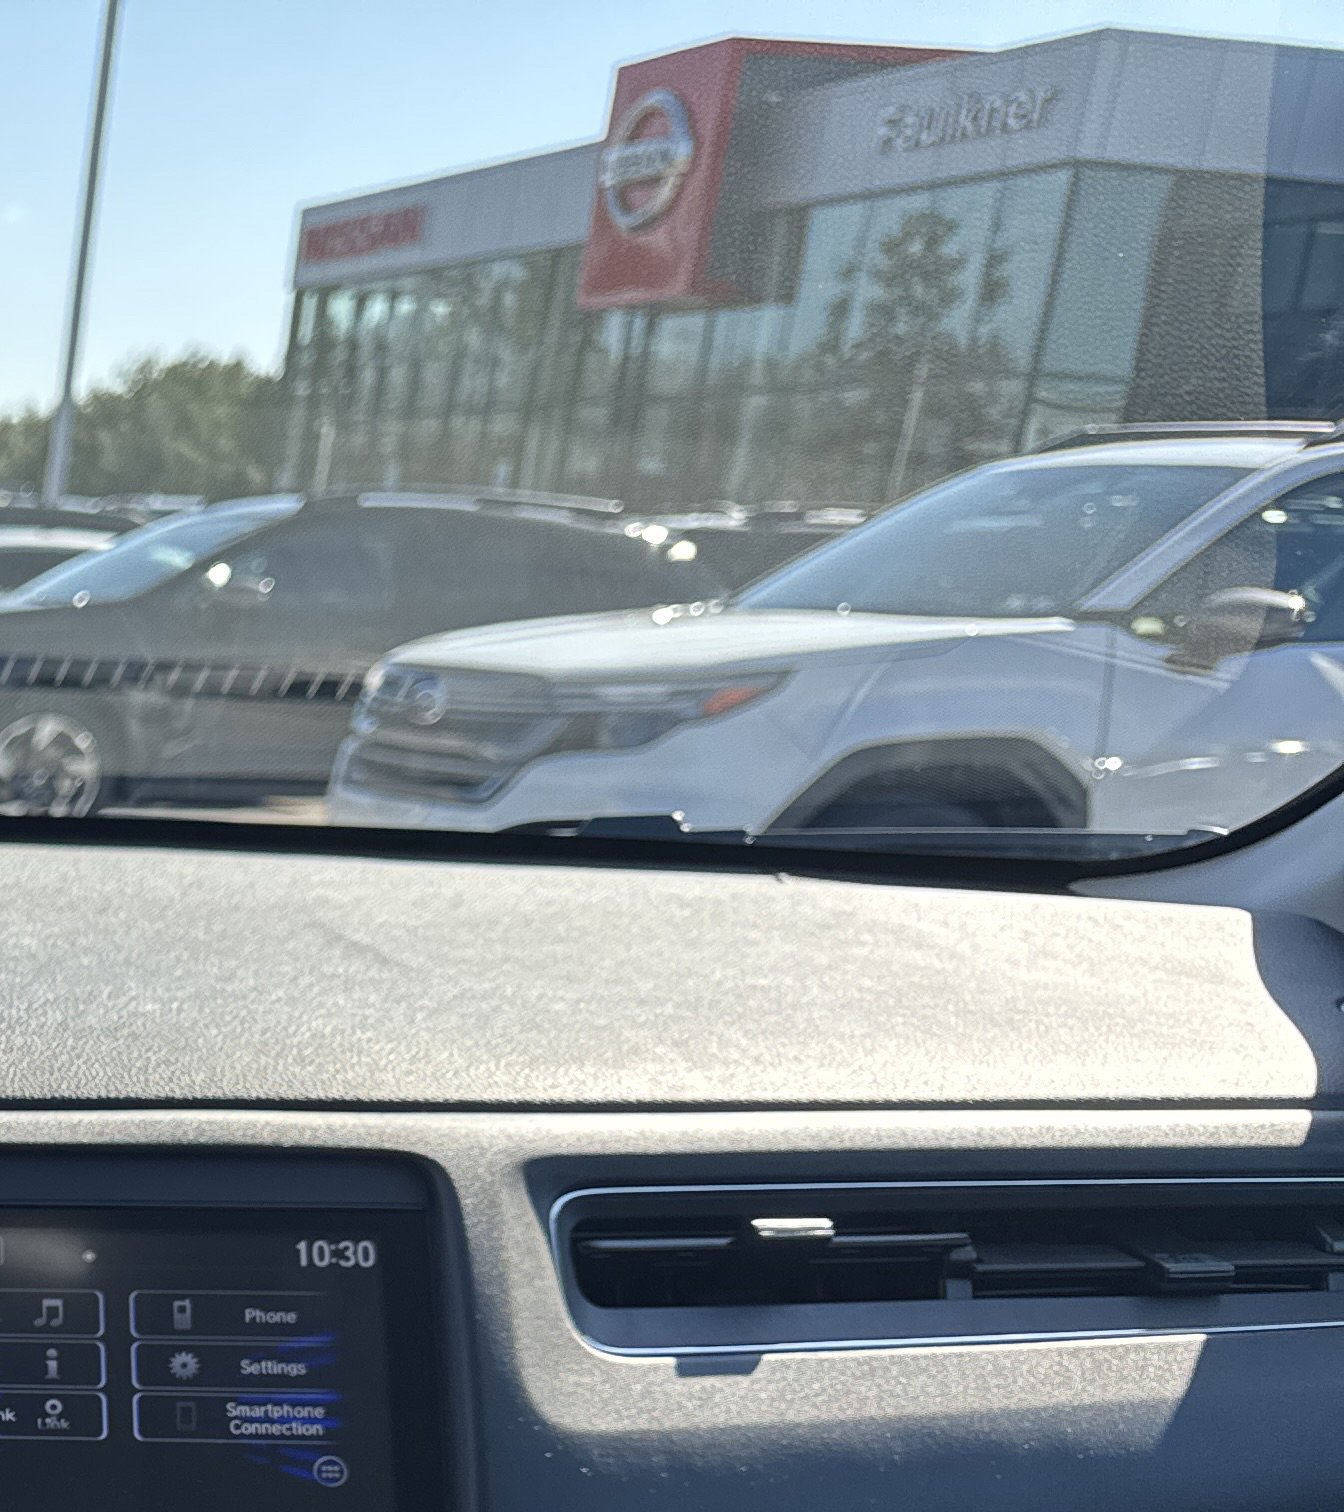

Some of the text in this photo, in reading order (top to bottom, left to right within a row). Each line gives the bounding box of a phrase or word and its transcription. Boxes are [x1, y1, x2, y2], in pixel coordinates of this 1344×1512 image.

[295, 1239, 376, 1268] 10:30
[244, 1307, 298, 1324] Phone
[240, 1359, 307, 1377] Settings
[225, 1401, 325, 1420] Smartphone
[229, 1419, 324, 1436] Connection
